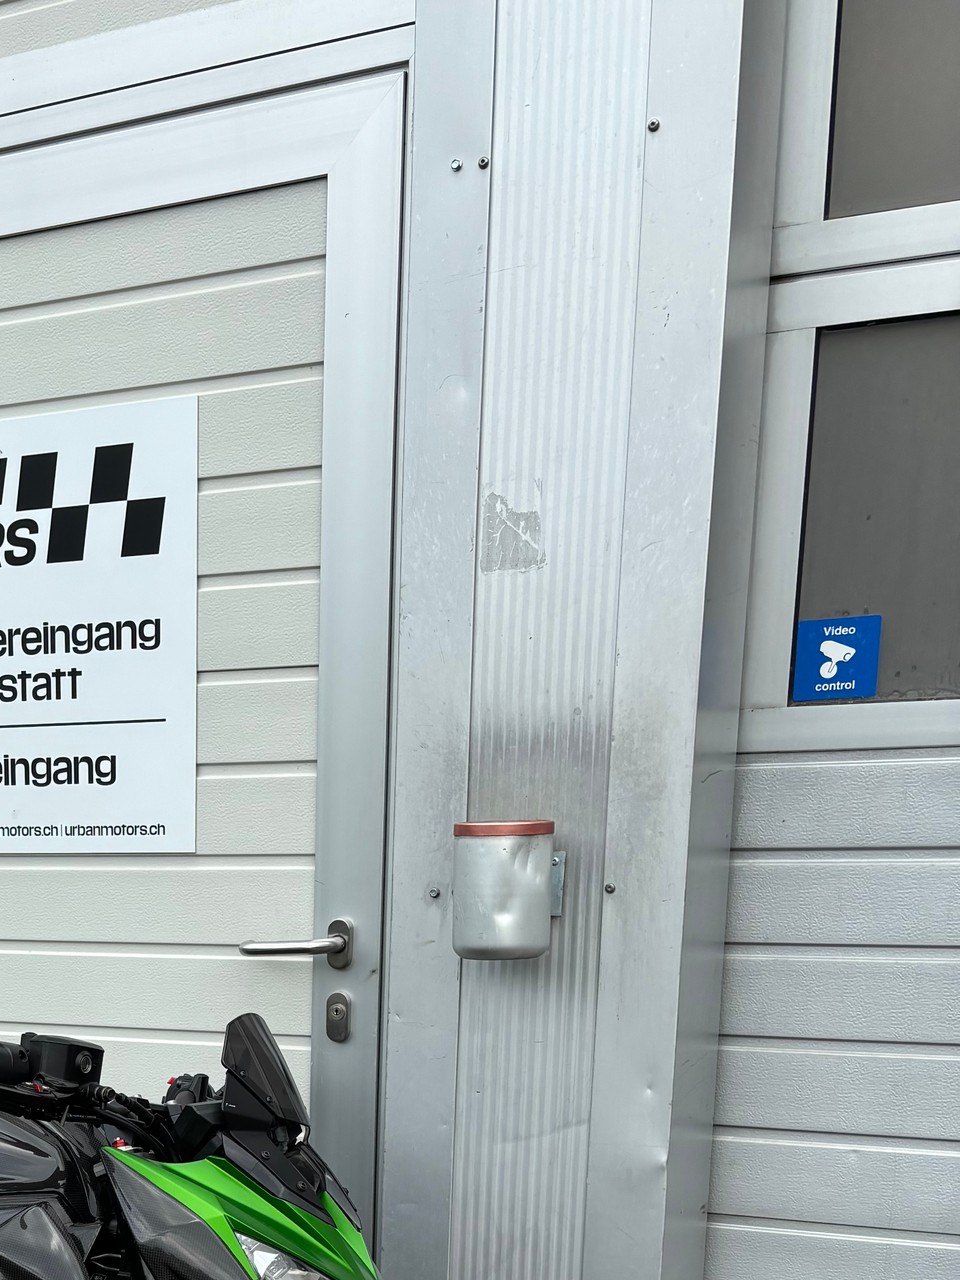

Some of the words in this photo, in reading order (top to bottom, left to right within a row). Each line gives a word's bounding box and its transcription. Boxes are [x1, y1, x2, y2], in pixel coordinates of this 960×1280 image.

[823, 626, 856, 636] Video
[815, 680, 856, 691] control
[65, 824, 166, 836] urbanmotors.ch
